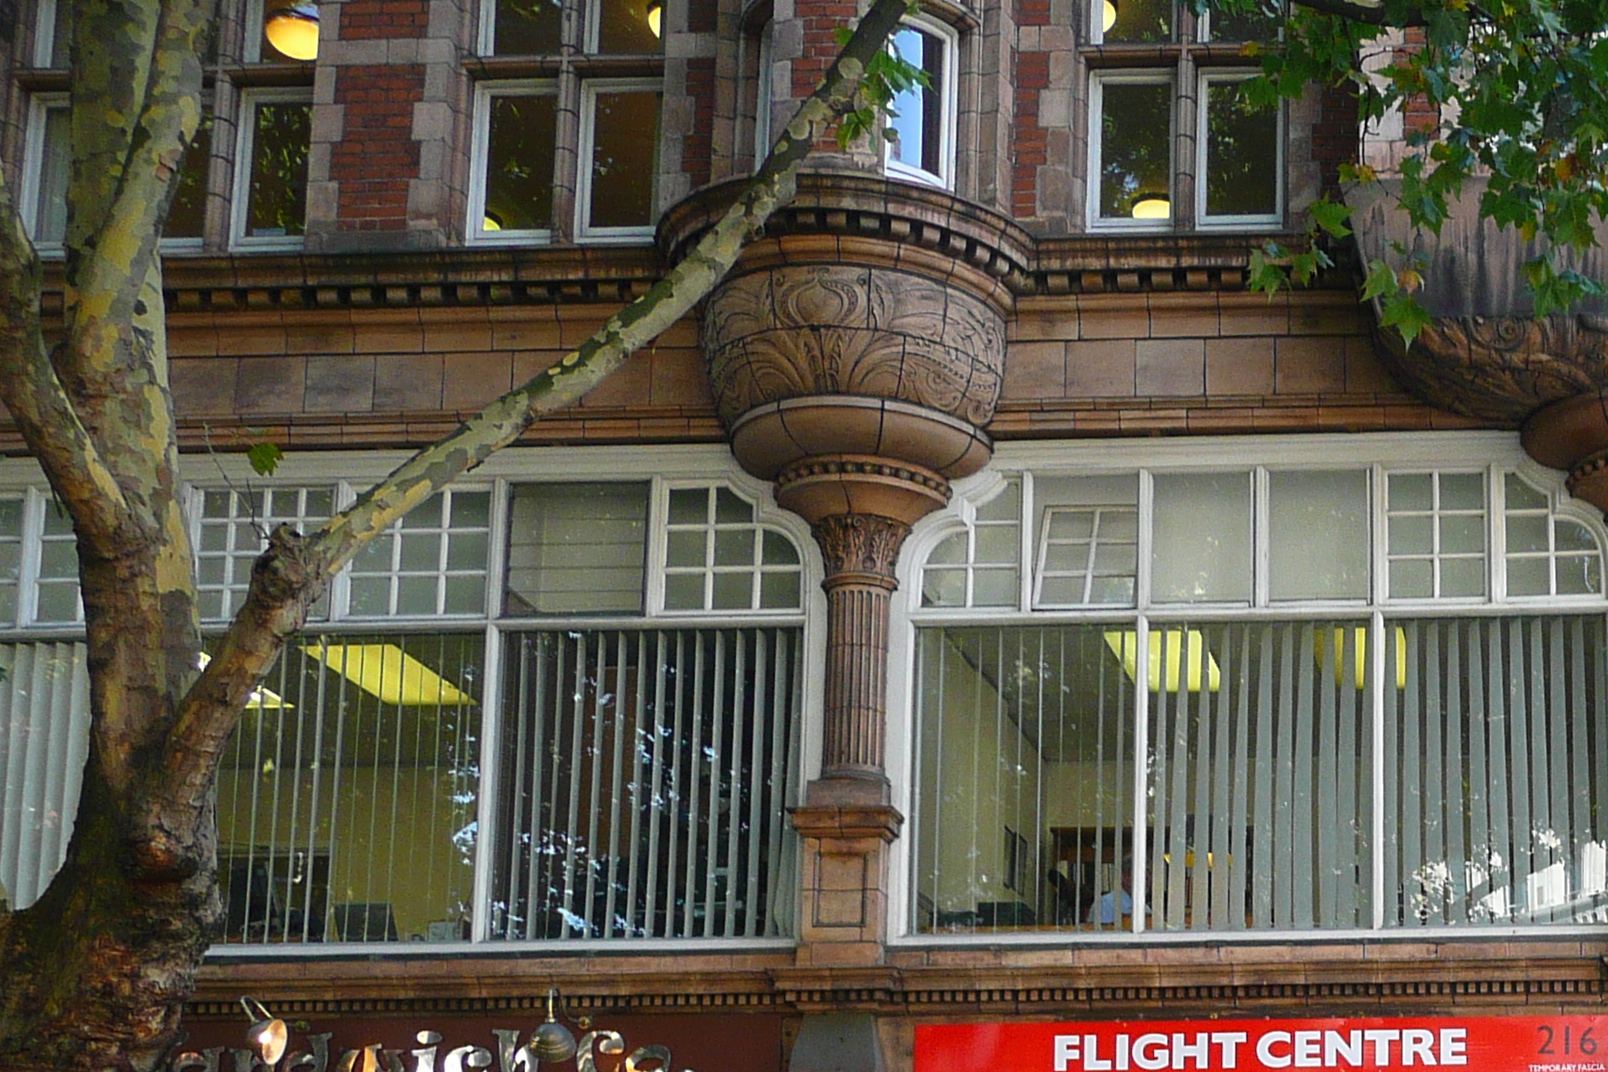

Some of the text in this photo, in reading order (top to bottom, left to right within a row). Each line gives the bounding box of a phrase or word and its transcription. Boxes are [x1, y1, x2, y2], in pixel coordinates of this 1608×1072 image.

[1053, 1027, 1468, 1072] FLIGHT CENTRE
[1537, 1025, 1598, 1056] 216
[1528, 1062, 1606, 1072] TEMPORARY FASCIA
